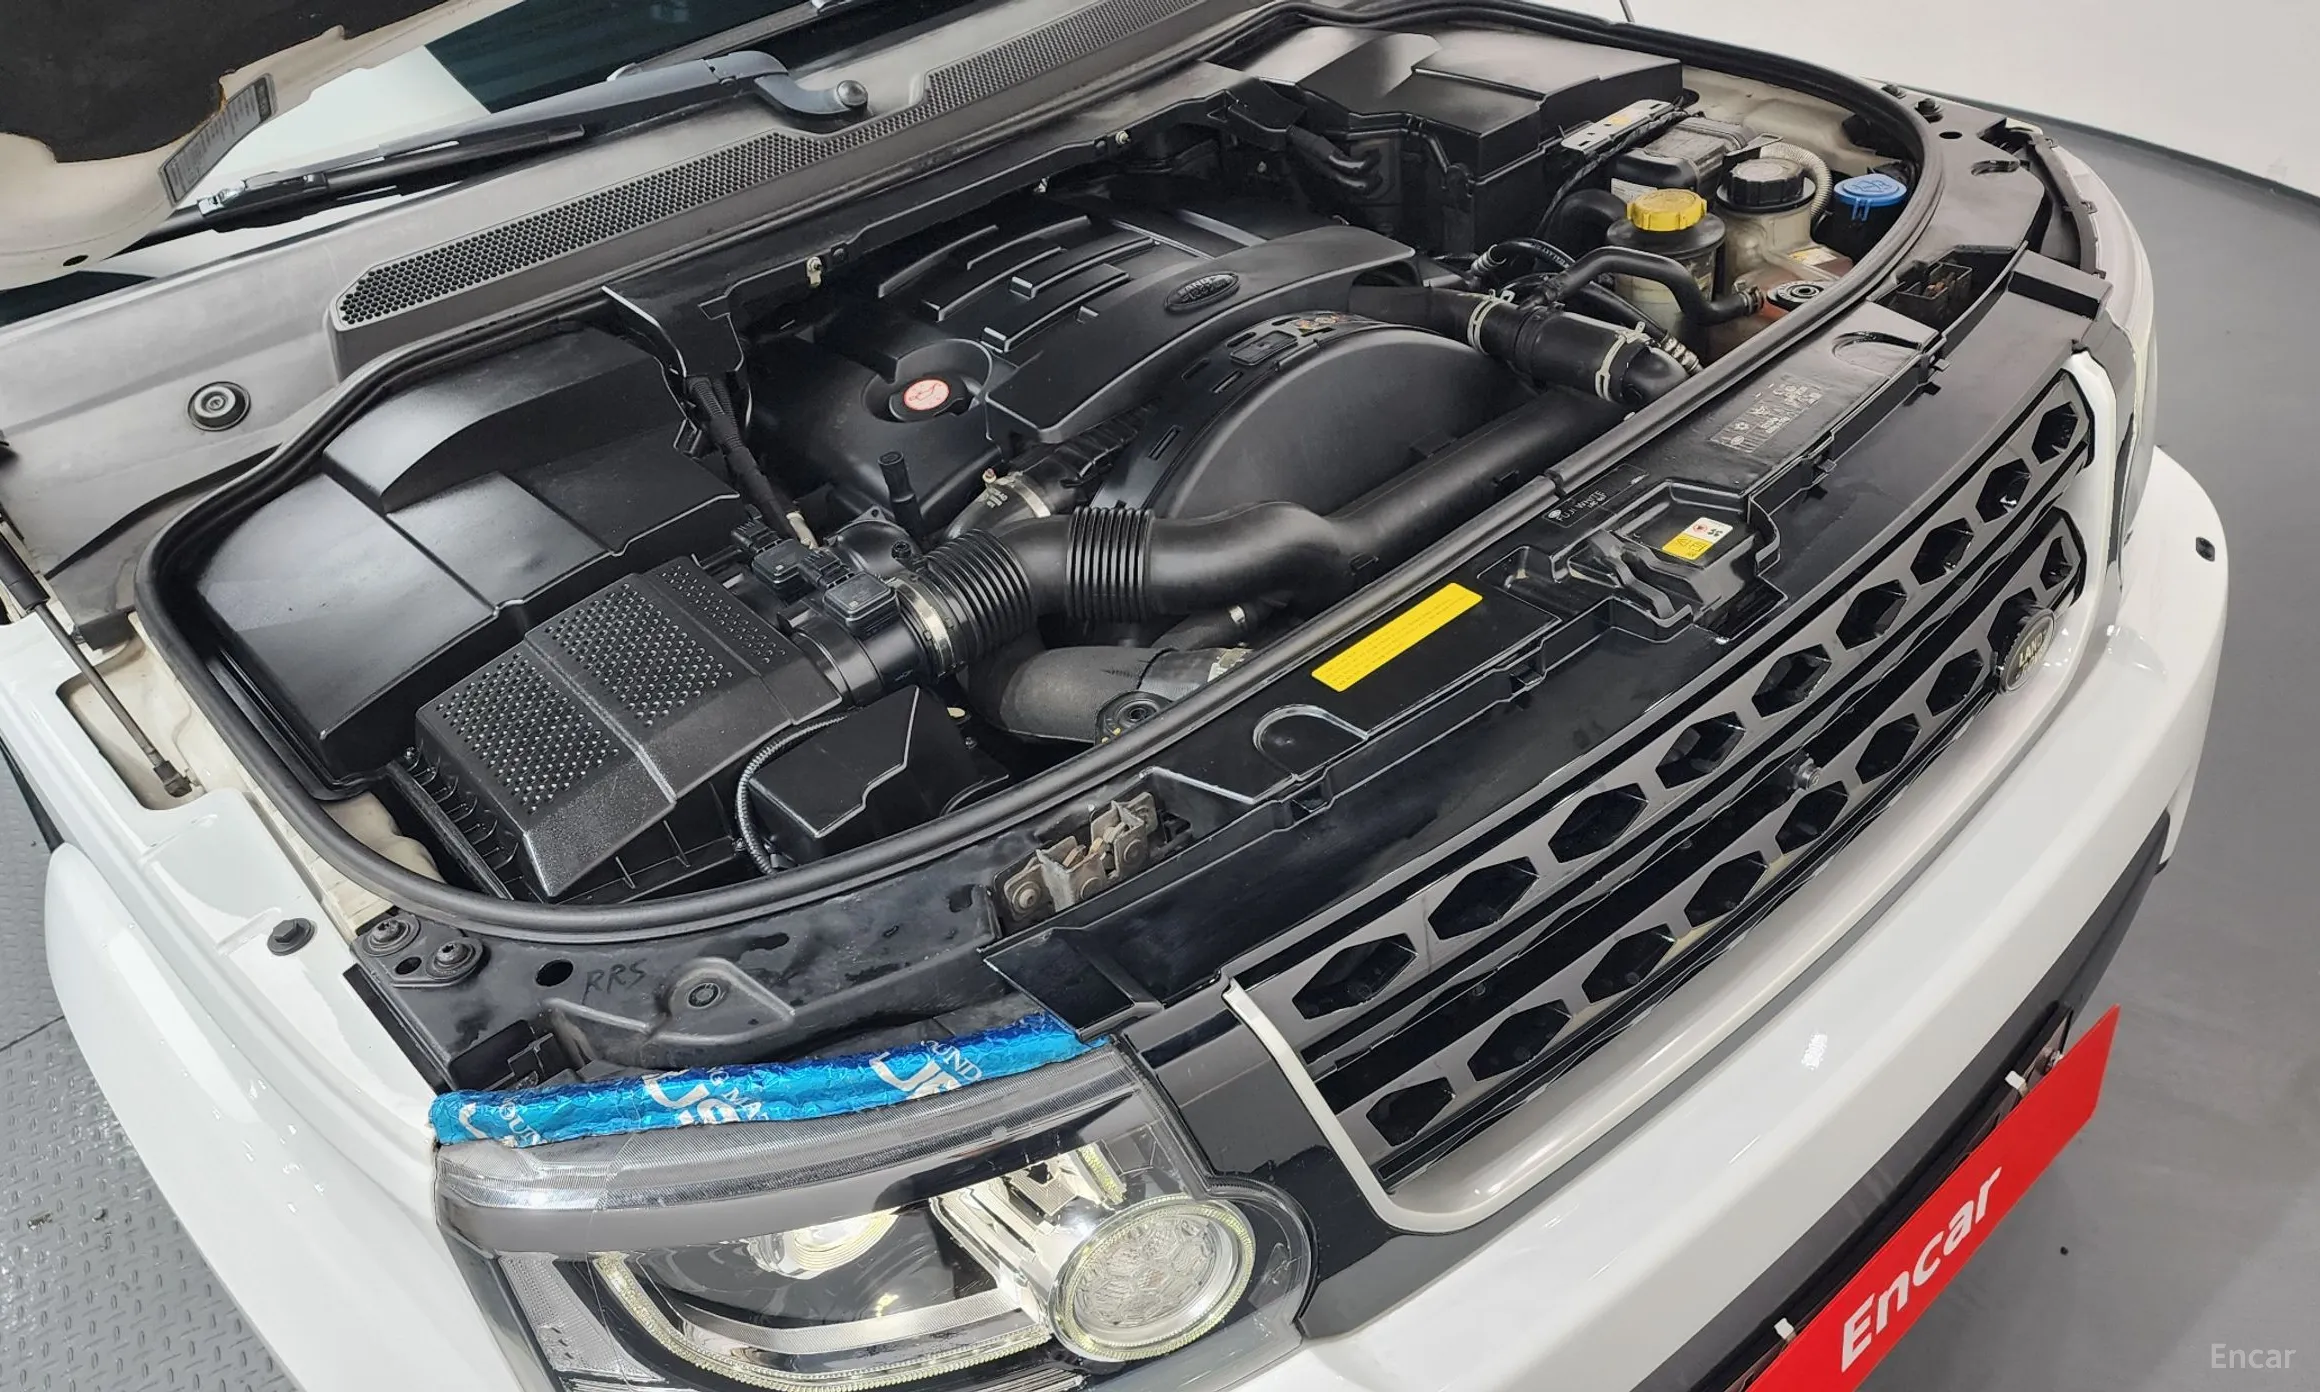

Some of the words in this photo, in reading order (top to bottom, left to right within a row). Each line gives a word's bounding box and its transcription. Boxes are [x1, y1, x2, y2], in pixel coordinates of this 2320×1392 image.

[2018, 632, 2043, 668] LAND
[581, 958, 648, 1005] RRS
[1842, 1166, 2002, 1373] Encar
